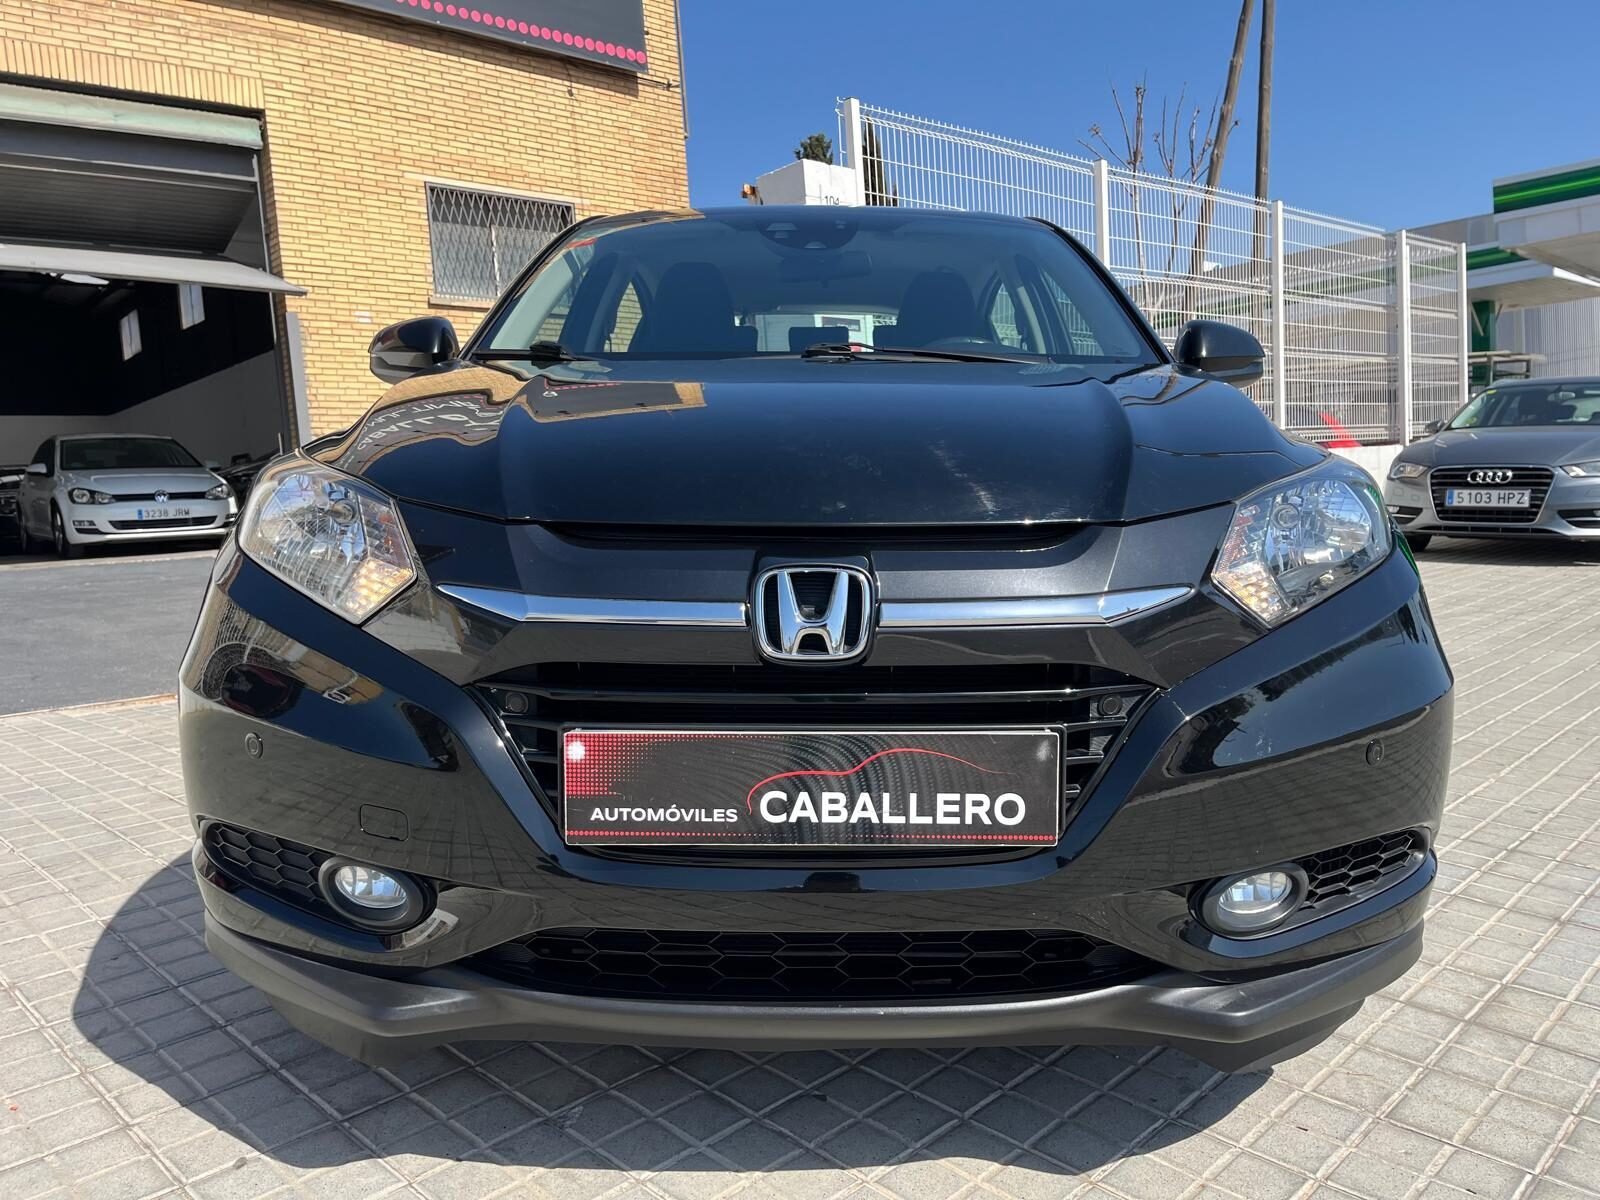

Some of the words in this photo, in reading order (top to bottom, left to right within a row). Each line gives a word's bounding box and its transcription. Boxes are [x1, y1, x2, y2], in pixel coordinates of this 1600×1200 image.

[1457, 491, 1492, 504] 5103
[1498, 491, 1525, 505] HPZ
[144, 508, 169, 518] 3238
[589, 803, 739, 823] AUTOMÓVILES
[759, 790, 1026, 826] CABALLERO
